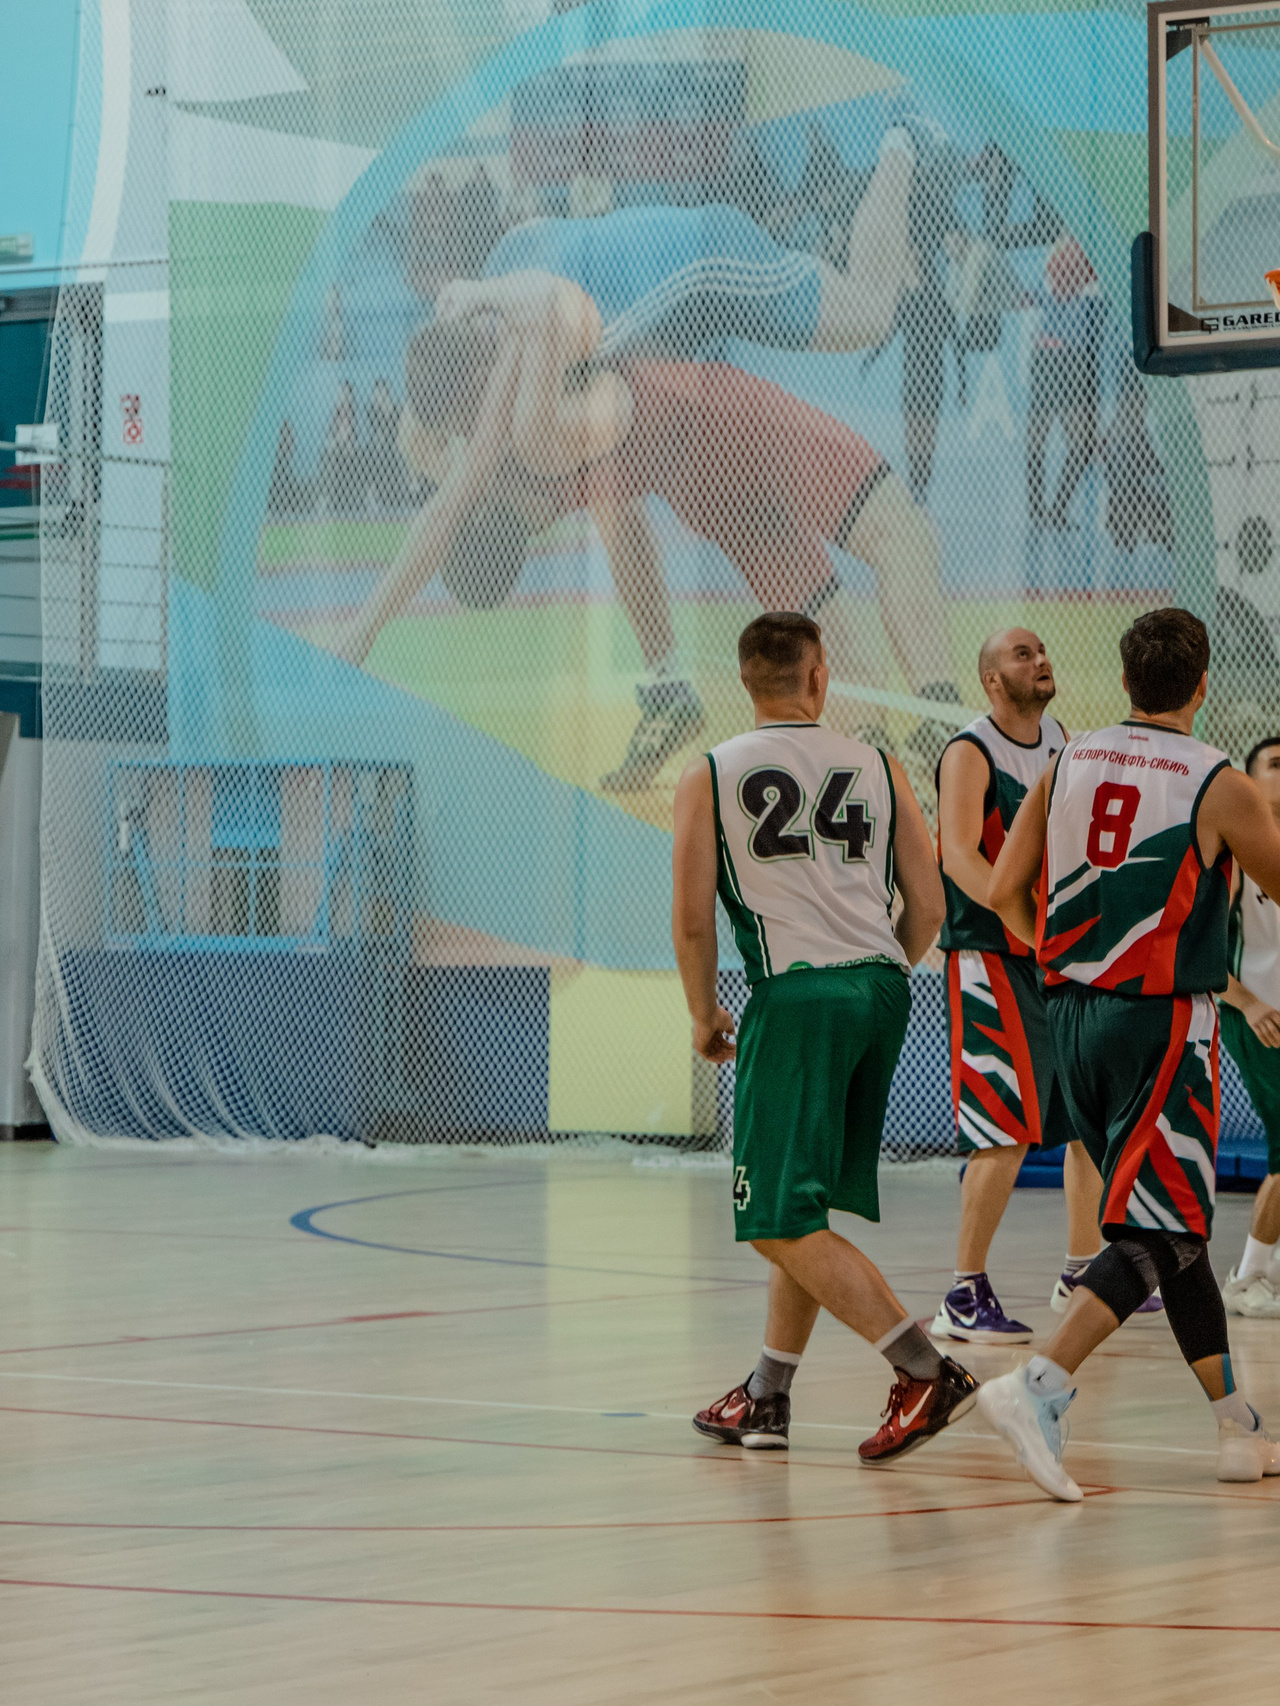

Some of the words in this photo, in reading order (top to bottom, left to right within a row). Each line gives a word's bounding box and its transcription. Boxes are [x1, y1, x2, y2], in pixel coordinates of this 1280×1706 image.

[1072, 748, 1190, 776] БЕЛОРУСНЕФТЬ-СИБИРЬ
[737, 764, 876, 864] 24
[1086, 781, 1141, 868] 8
